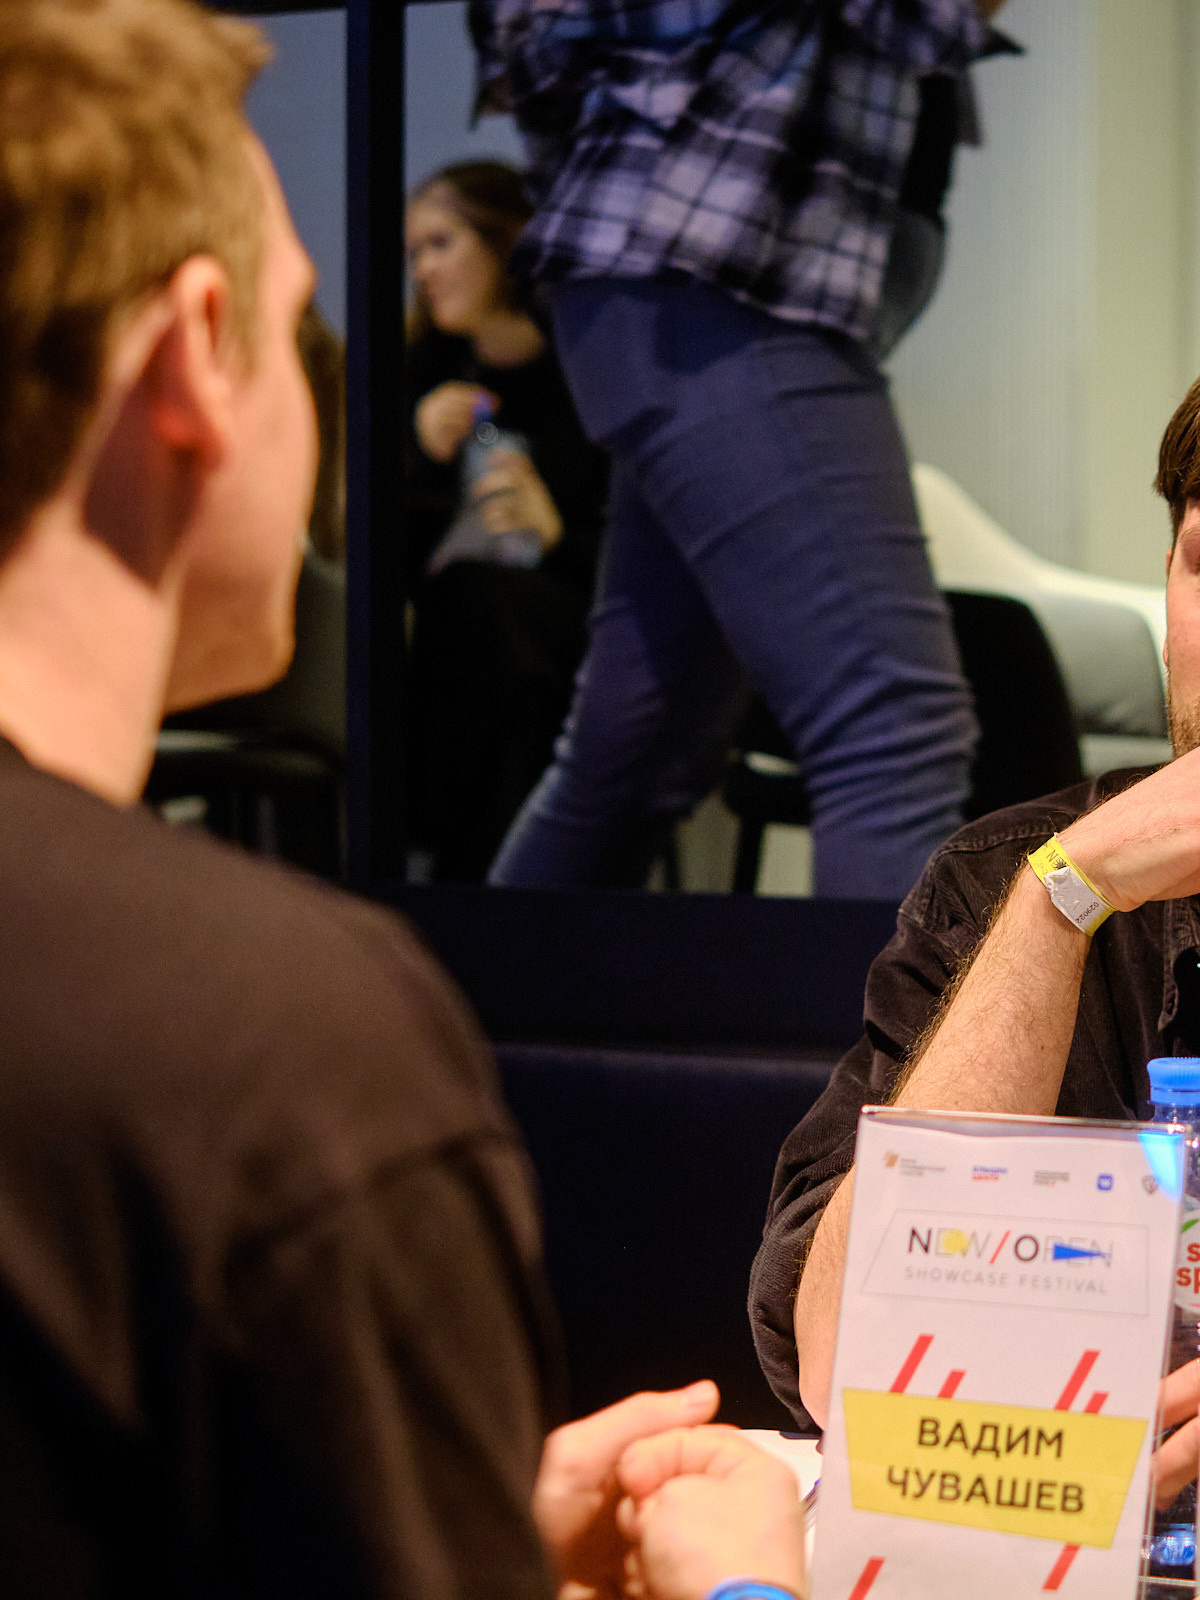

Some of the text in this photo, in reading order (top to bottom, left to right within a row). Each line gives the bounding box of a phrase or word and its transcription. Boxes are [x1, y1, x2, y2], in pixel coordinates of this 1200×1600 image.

[1075, 901, 1100, 924] 029022
[904, 1265, 1108, 1293] SHOWCASE FESTIVAL
[917, 1417, 1064, 1459] ВАДИМ
[887, 1465, 1085, 1514] ЧУВАШЕВ
